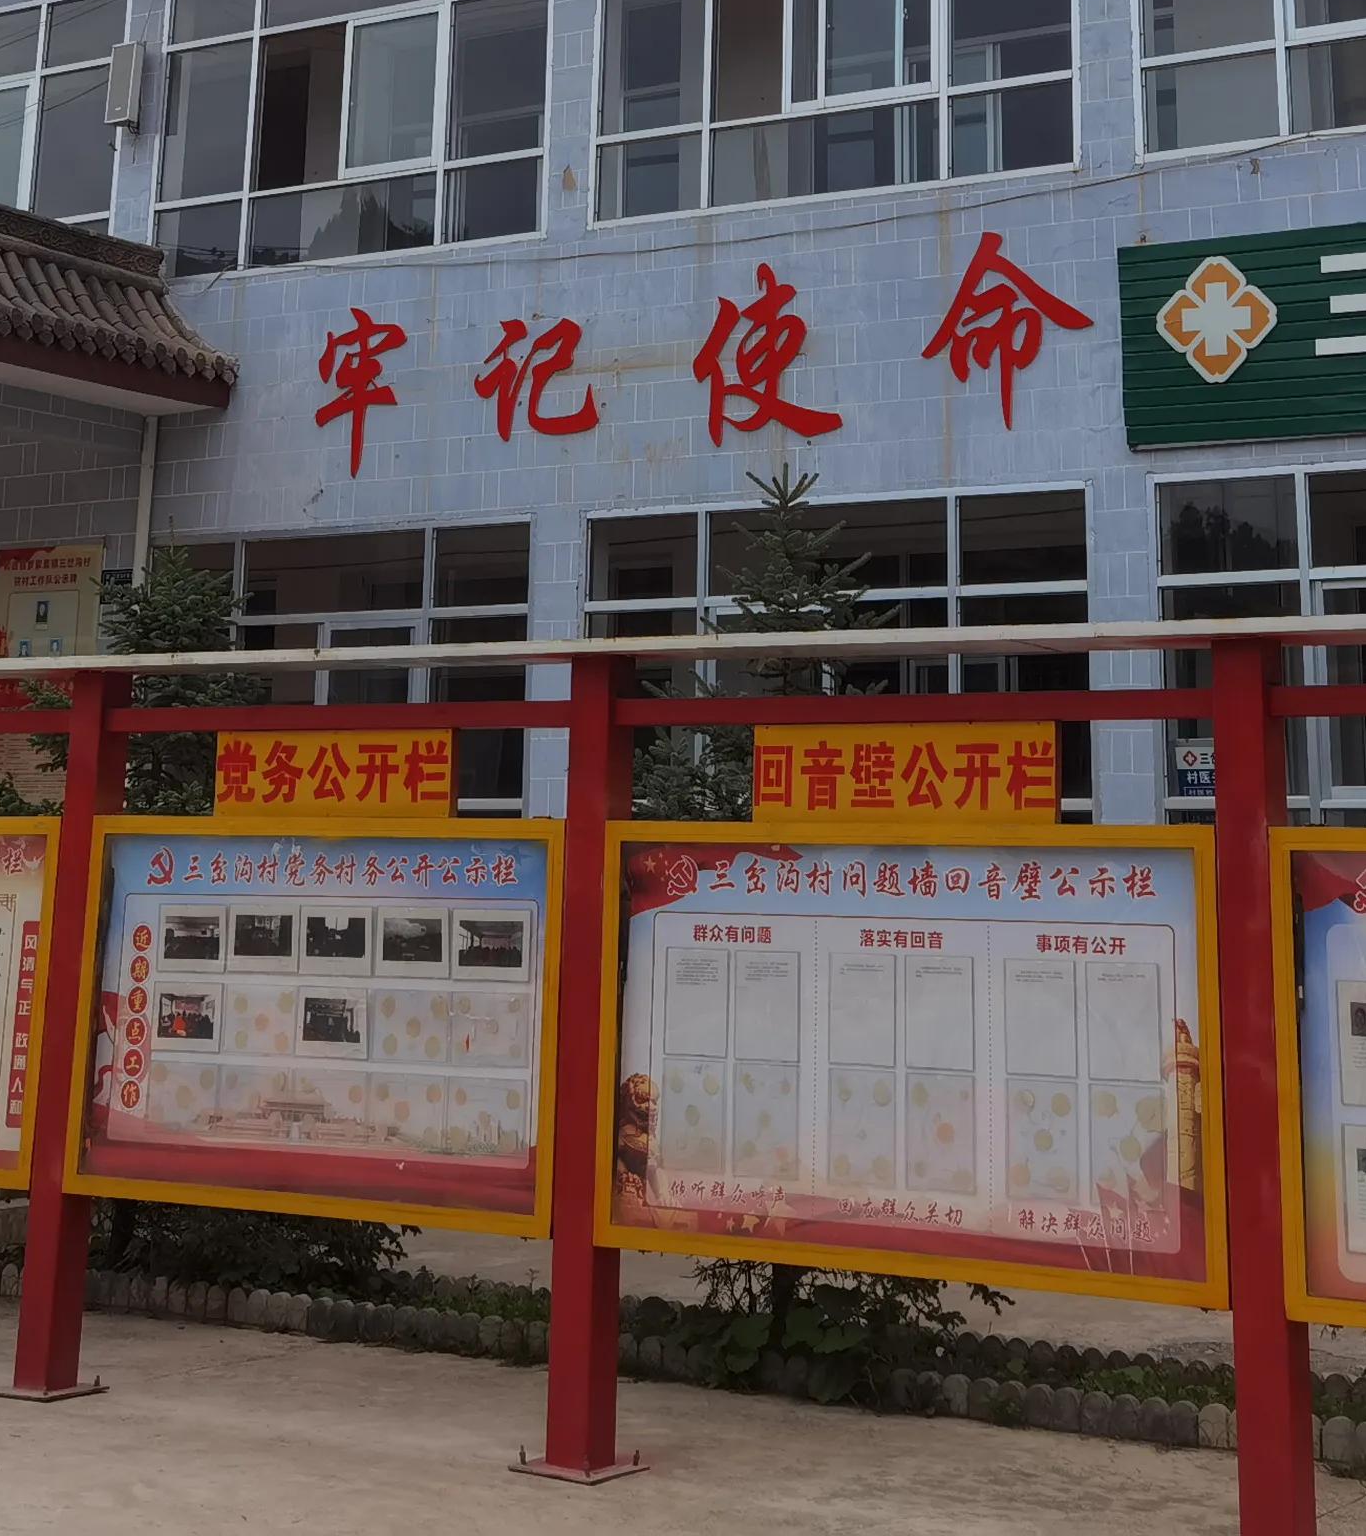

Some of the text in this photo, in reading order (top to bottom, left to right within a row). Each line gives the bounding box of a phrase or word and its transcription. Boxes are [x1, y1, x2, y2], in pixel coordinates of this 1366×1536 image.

[314, 231, 1094, 479] 牢记使命
[217, 740, 450, 804] 党务公开栏
[754, 740, 1056, 811] 回音壁公开栏
[182, 849, 520, 888] 三岔沟村党务村务公开公示栏
[707, 859, 1158, 901] 三岔沟村问题墙回音壁公示栏
[693, 924, 773, 945] 群众有问题
[859, 928, 944, 951] 落实有回音
[1036, 933, 1127, 956] 事项有公开
[122, 927, 153, 1107] 近期重点工作
[669, 1180, 787, 1208] 倾听群众呼声
[838, 1198, 964, 1228] 回应群众关切
[1019, 1208, 1155, 1244] 解决群众问题
